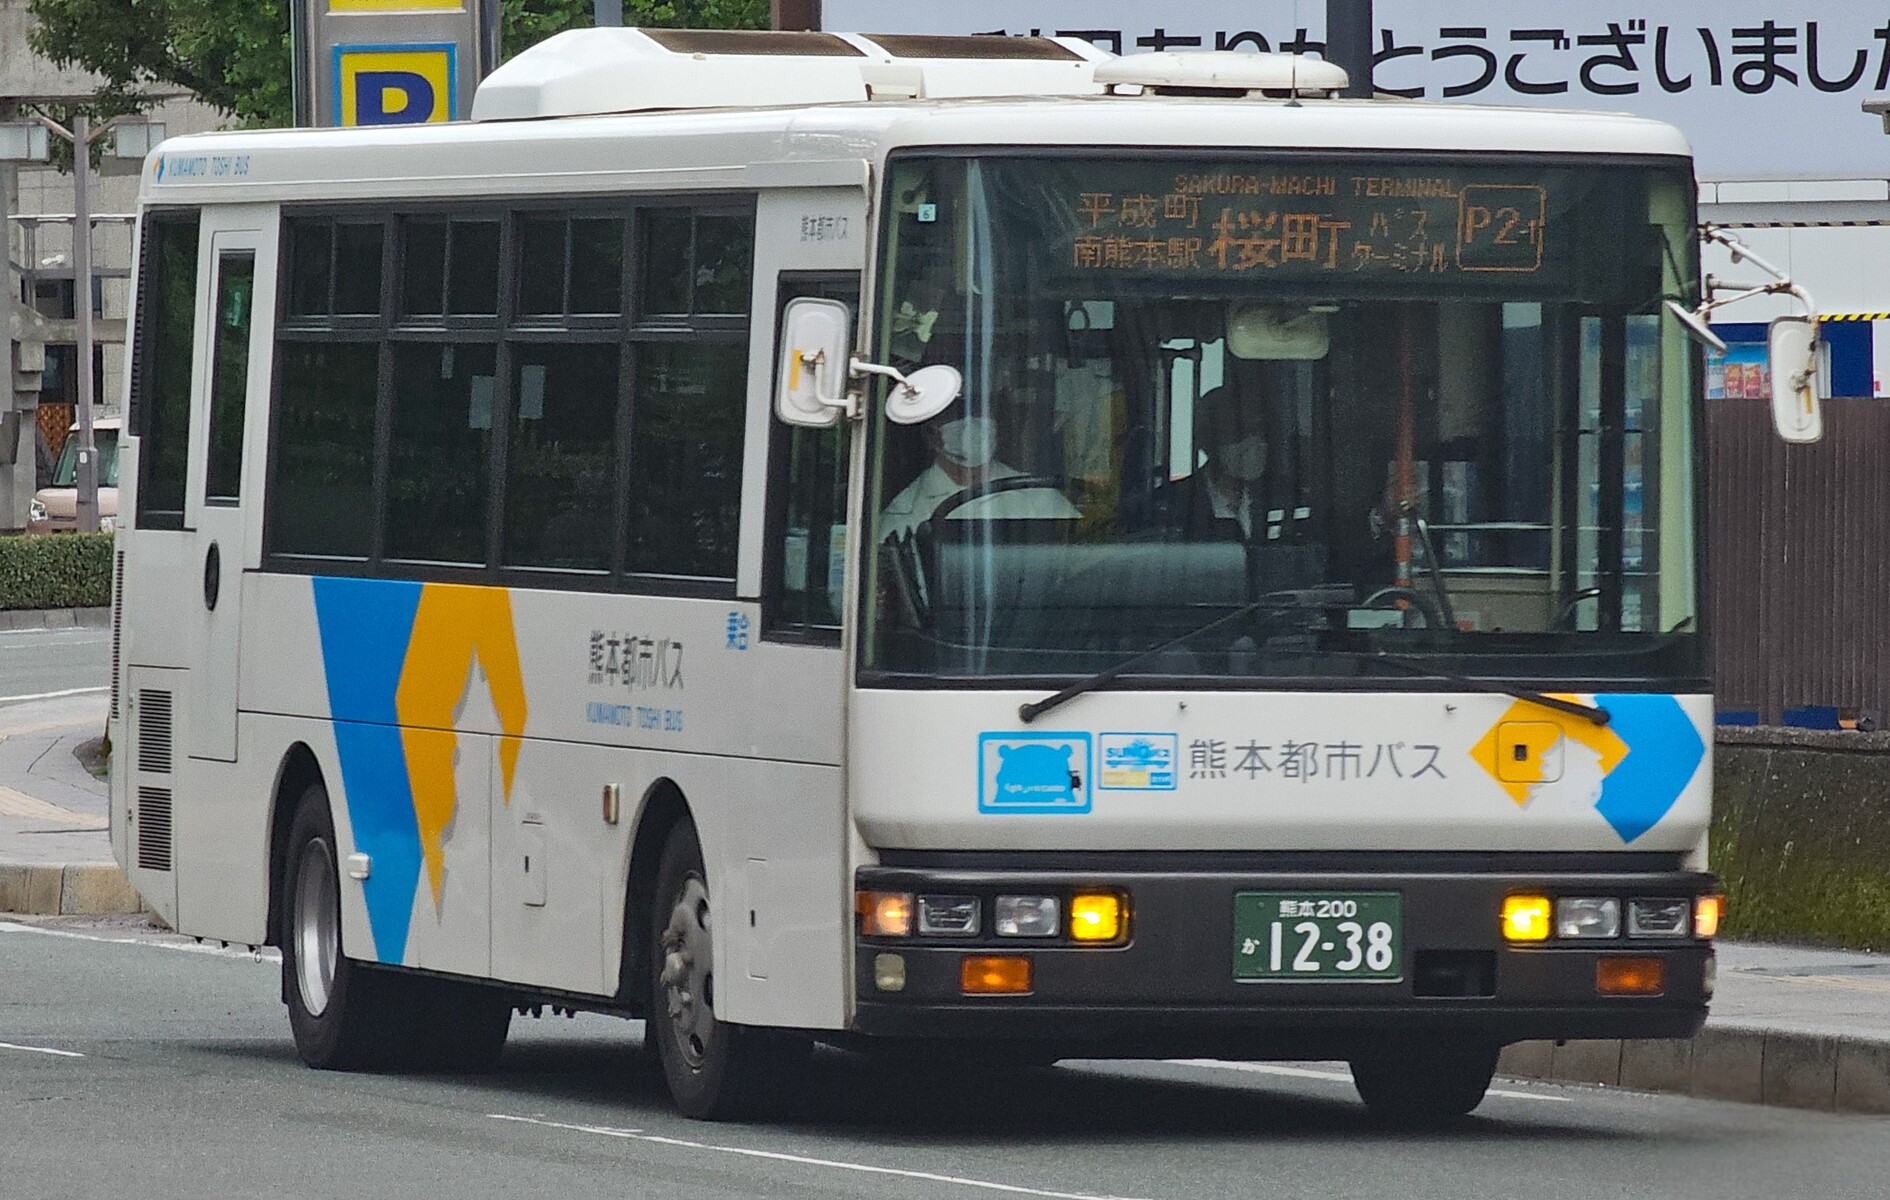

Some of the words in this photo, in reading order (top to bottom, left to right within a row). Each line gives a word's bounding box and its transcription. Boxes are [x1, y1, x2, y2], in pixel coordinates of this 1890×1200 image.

[355, 71, 434, 126] P
[1174, 175, 1336, 195] SAKURA-MACHI
[1351, 177, 1457, 198] TERMINAL
[1078, 192, 1203, 228] 平成町
[1369, 208, 1428, 241] バス
[1073, 235, 1201, 268] 南熊本駅
[1209, 208, 1351, 270] 桜町
[588, 629, 684, 691] 熊本都市バス
[664, 709, 683, 731] BUS
[1189, 738, 1448, 784] 熊本都市バス
[1279, 900, 1357, 918] 熊本200
[1241, 938, 1260, 955] か
[1270, 921, 1393, 972] 12-38
